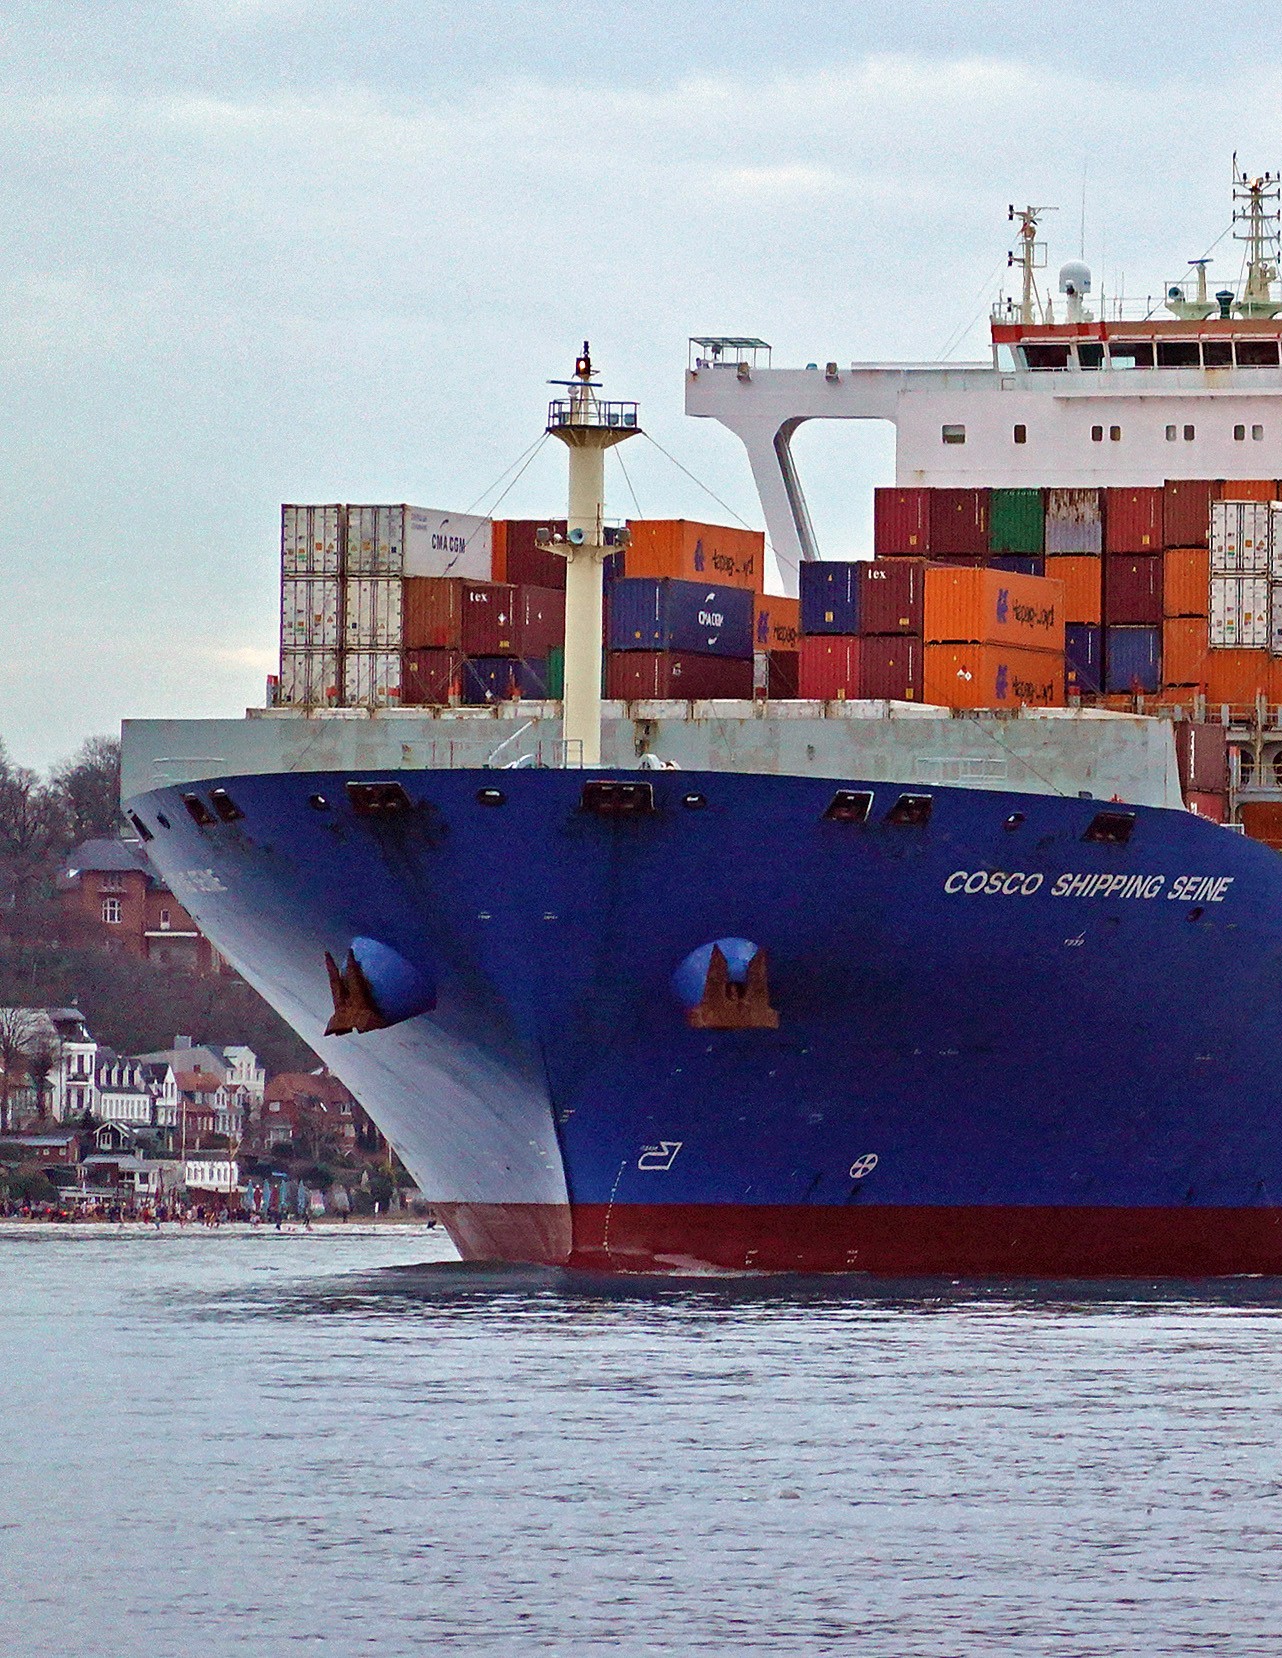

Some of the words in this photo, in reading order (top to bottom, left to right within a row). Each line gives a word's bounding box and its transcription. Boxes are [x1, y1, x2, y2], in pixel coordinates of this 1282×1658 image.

[432, 534, 448, 551] CMA
[449, 536, 466, 553] CGM
[868, 569, 887, 580] tex
[469, 591, 488, 602] tex
[944, 870, 1044, 895] COSCO
[1051, 873, 1165, 899] SHIPPING
[1167, 876, 1235, 902] SEINE
